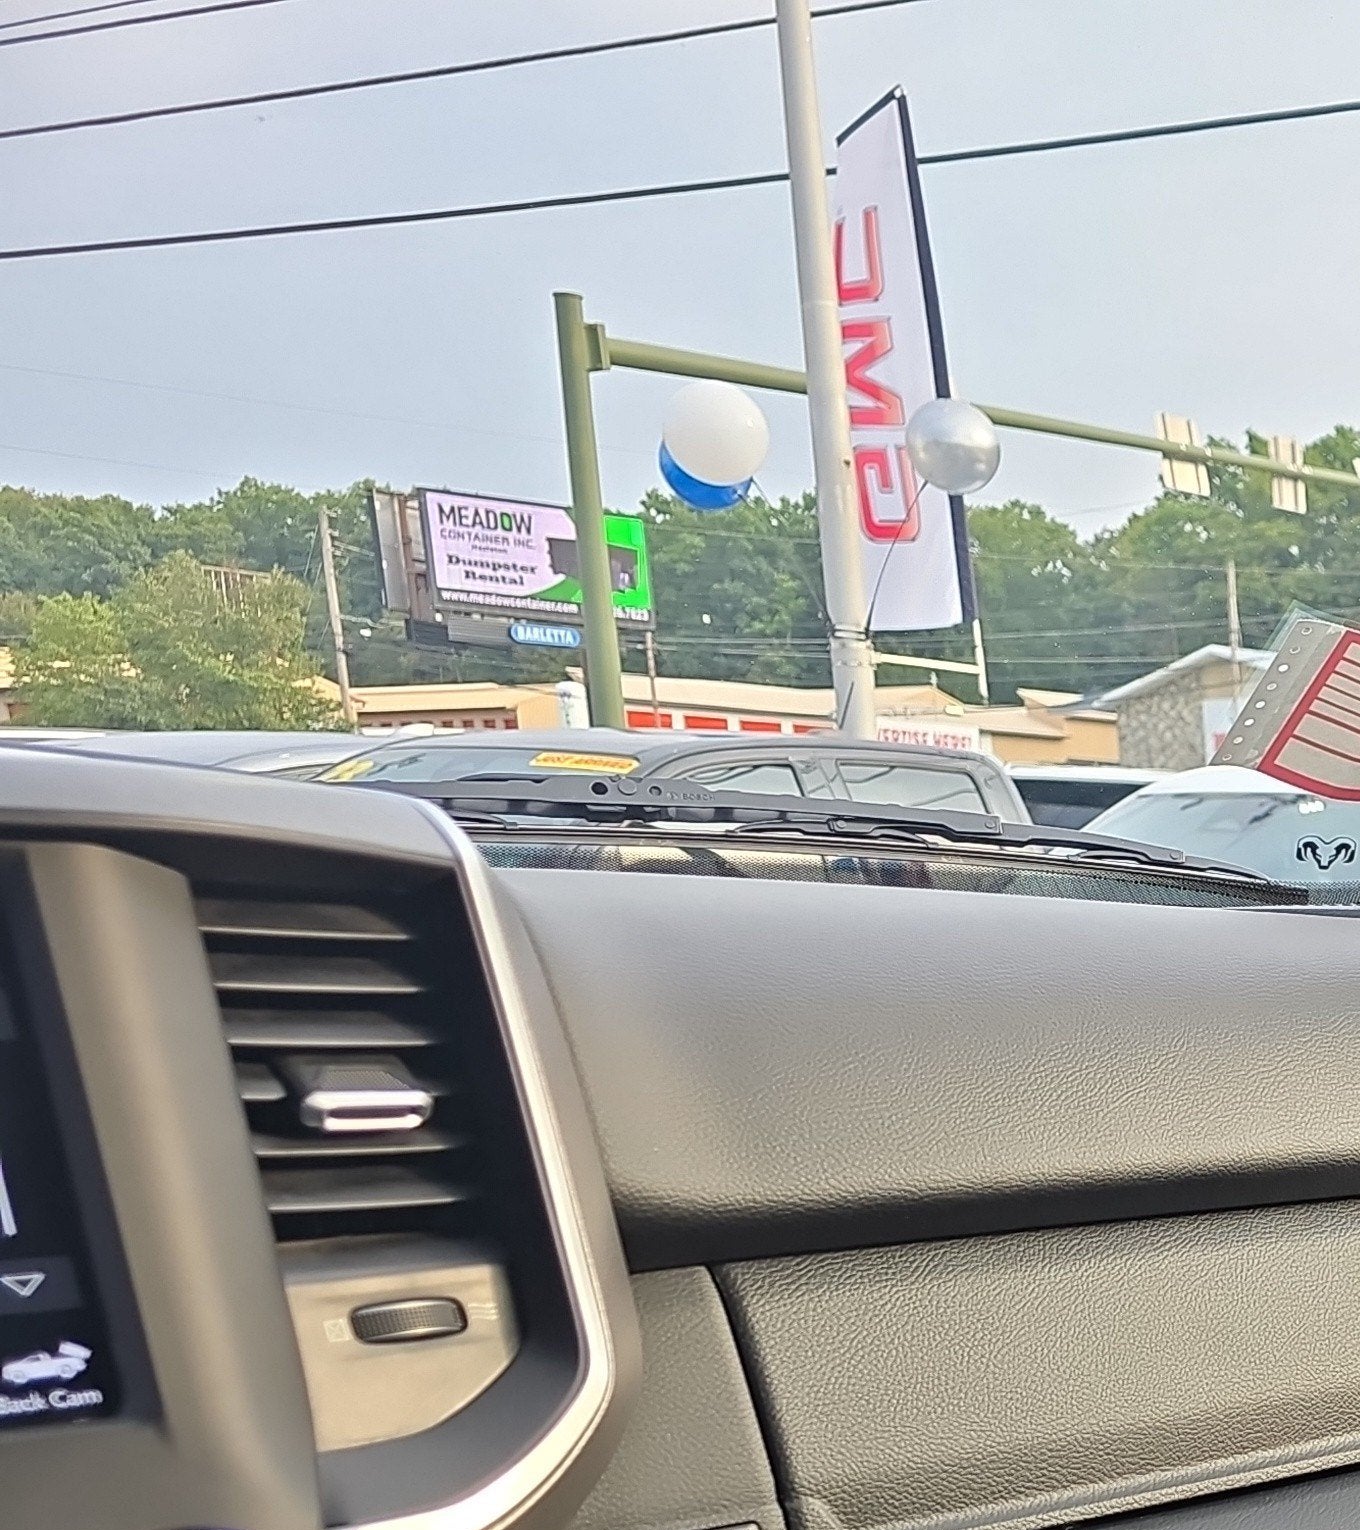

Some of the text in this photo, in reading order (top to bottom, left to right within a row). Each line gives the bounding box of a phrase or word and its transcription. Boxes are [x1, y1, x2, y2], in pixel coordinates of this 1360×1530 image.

[437, 502, 532, 535] MEADOW
[440, 528, 510, 547] CONTAINER
[513, 536, 537, 550] INC.
[446, 554, 538, 574] Dumpster
[463, 570, 525, 586] Rental
[516, 624, 575, 644] BARLETTA
[48, 1389, 104, 1409] Cam
